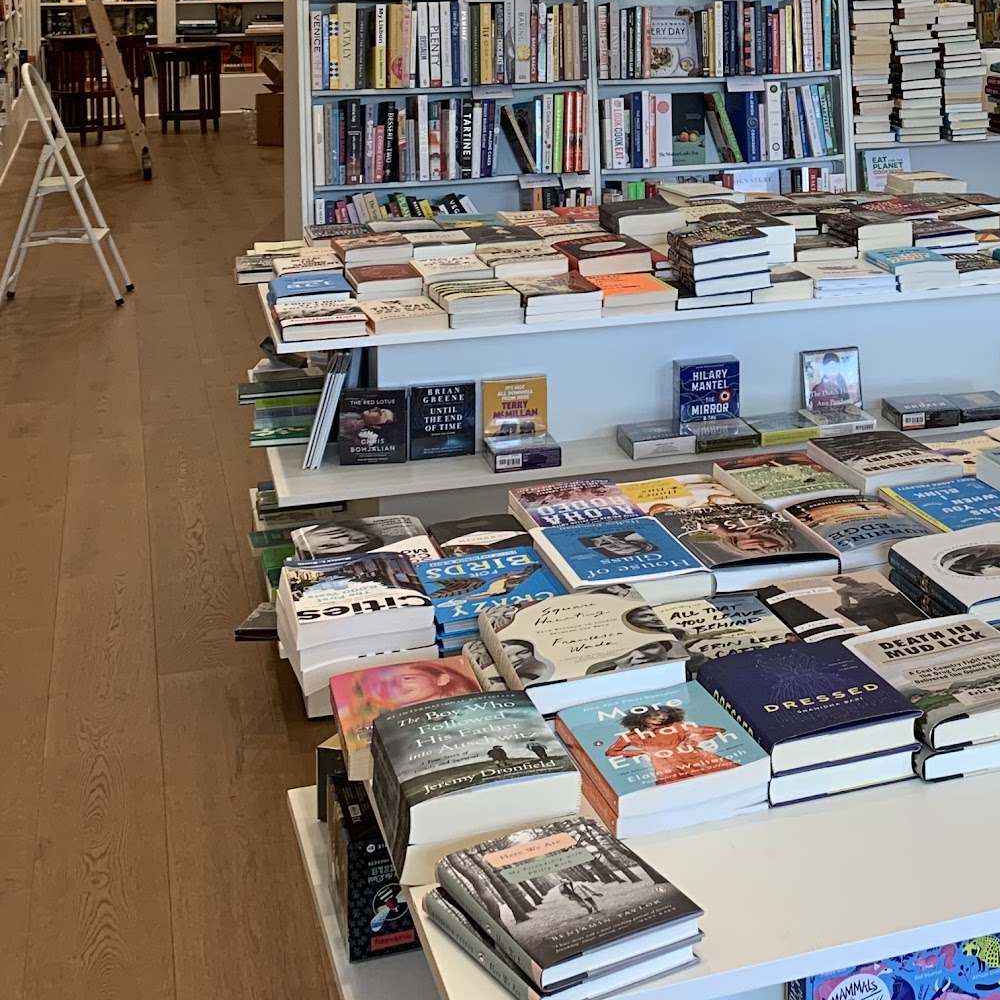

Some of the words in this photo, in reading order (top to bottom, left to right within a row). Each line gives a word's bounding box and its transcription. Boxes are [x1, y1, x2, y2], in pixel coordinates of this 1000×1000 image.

[378, 8, 384, 18] My
[343, 21, 351, 60] EATALY
[431, 26, 440, 66] PLENTY
[463, 114, 472, 155] TARTINE
[614, 128, 623, 146] COOK
[614, 147, 624, 160] EAT
[692, 368, 728, 382] HILARY
[427, 387, 460, 395] BRIAN
[691, 378, 730, 392] MANTEL
[423, 395, 465, 403] GREENE
[502, 401, 528, 409] TERRY
[691, 401, 730, 416] MIRROR
[430, 406, 458, 414] UNTIL
[425, 424, 437, 432] OF
[439, 422, 463, 431] TIME
[350, 445, 395, 453] BOHJALIAN
[915, 488, 959, 499] BLINK
[951, 494, 998, 504] WHEN
[941, 505, 974, 513] YOU
[426, 553, 538, 579] BIRDS
[477, 568, 503, 578] FOR
[299, 594, 433, 620] Cities
[677, 618, 705, 627] YOU
[714, 608, 766, 621] LEAVE
[693, 617, 762, 634] BEHIND
[877, 630, 948, 650] DEATH
[949, 623, 972, 634] IN
[884, 645, 937, 660] MUD
[939, 630, 987, 648] LICK
[914, 674, 949, 684] Delivered
[963, 667, 986, 677] Opioid
[763, 682, 880, 713] DRESSED
[968, 688, 988, 697] Eric
[398, 716, 420, 727] The
[425, 707, 462, 721] Boy
[466, 701, 515, 711] Who
[597, 699, 683, 722] More
[418, 711, 505, 734] Followed
[614, 721, 698, 743] Than
[415, 734, 453, 748] His
[459, 723, 520, 737] Father
[408, 750, 433, 761] into
[439, 731, 539, 754] Auschwitz
[608, 731, 738, 770] Enough
[627, 768, 672, 783] Elaine
[676, 750, 747, 772] Welteroth
[423, 774, 476, 795] Jeremy
[480, 759, 556, 779] Dronfield
[499, 850, 523, 860] Here
[545, 839, 561, 848] Are
[508, 868, 521, 876] My
[523, 857, 564, 872] Friendship
[566, 851, 583, 860] with
